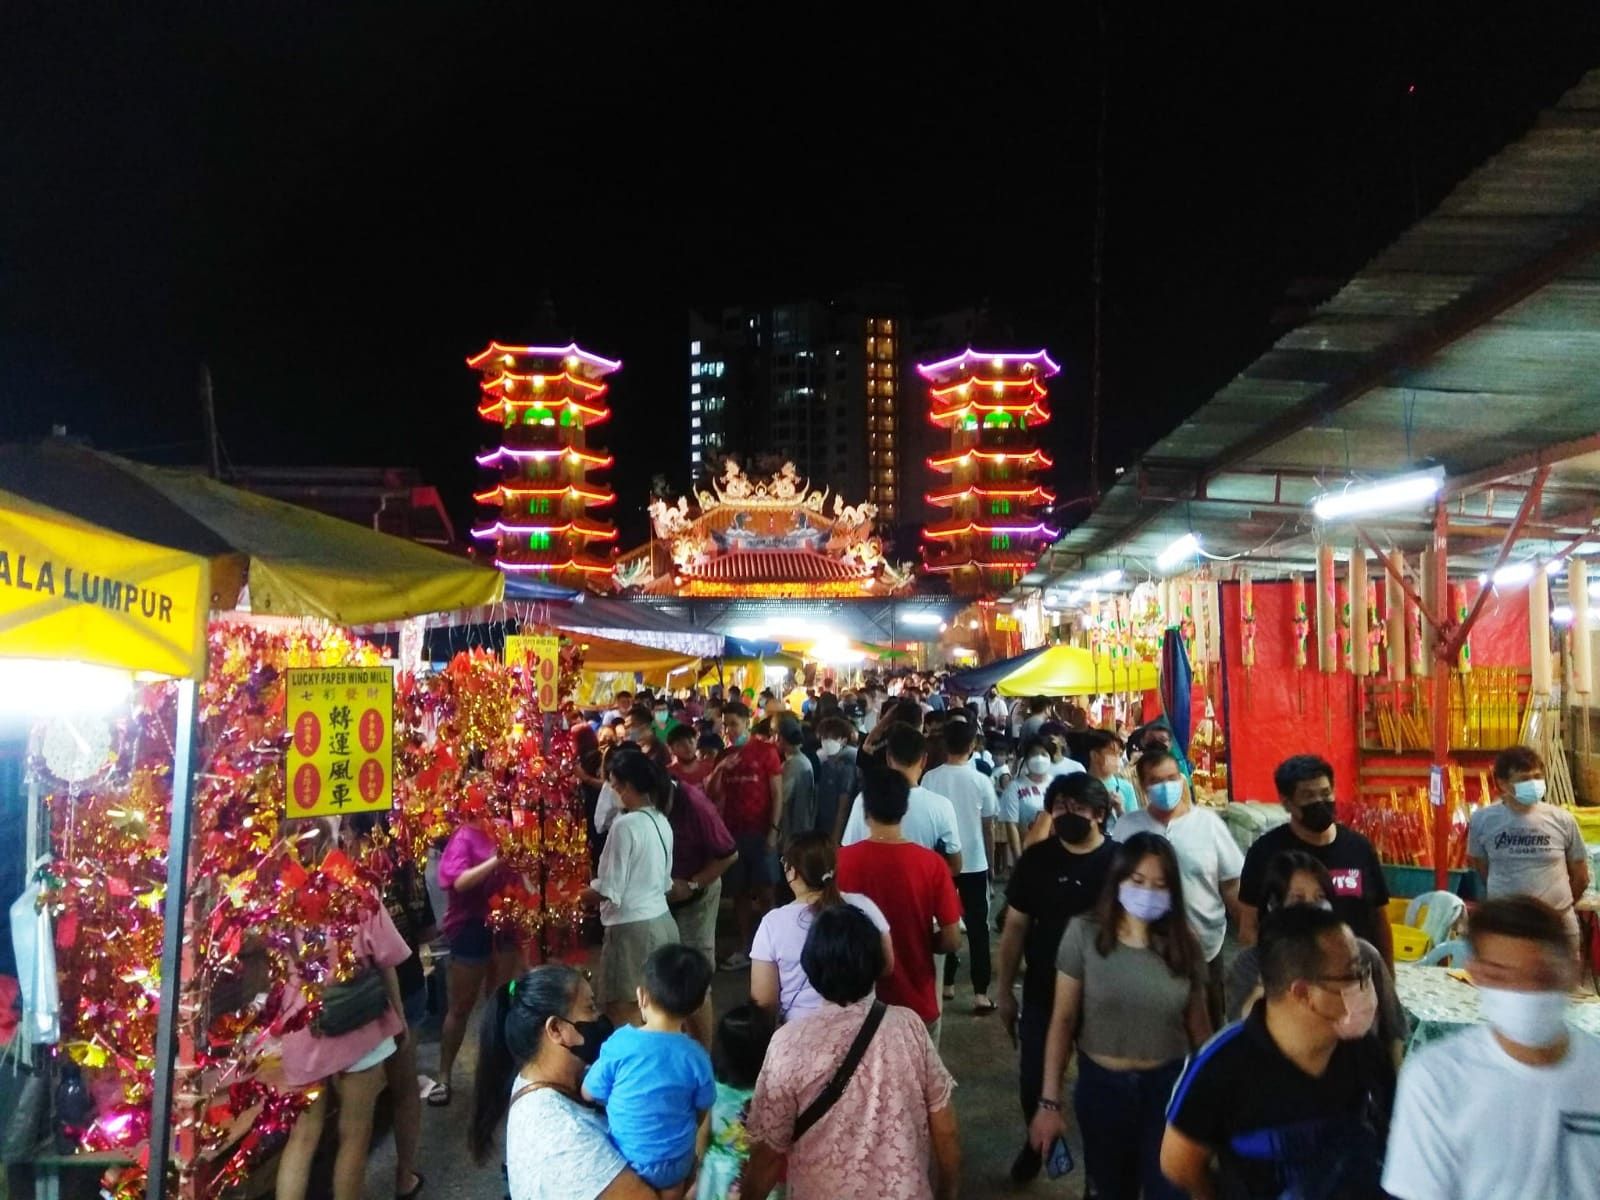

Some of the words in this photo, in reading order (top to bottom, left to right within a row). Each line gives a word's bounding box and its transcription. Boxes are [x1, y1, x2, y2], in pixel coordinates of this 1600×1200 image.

[64, 567, 173, 623] LUMPUR
[292, 672, 319, 686] LUCKY
[320, 672, 346, 685] PAPER
[348, 671, 369, 684] WIND
[370, 671, 388, 684] MILL
[329, 705, 354, 808] 轉運風車
[1494, 831, 1551, 850] AVENGERS
